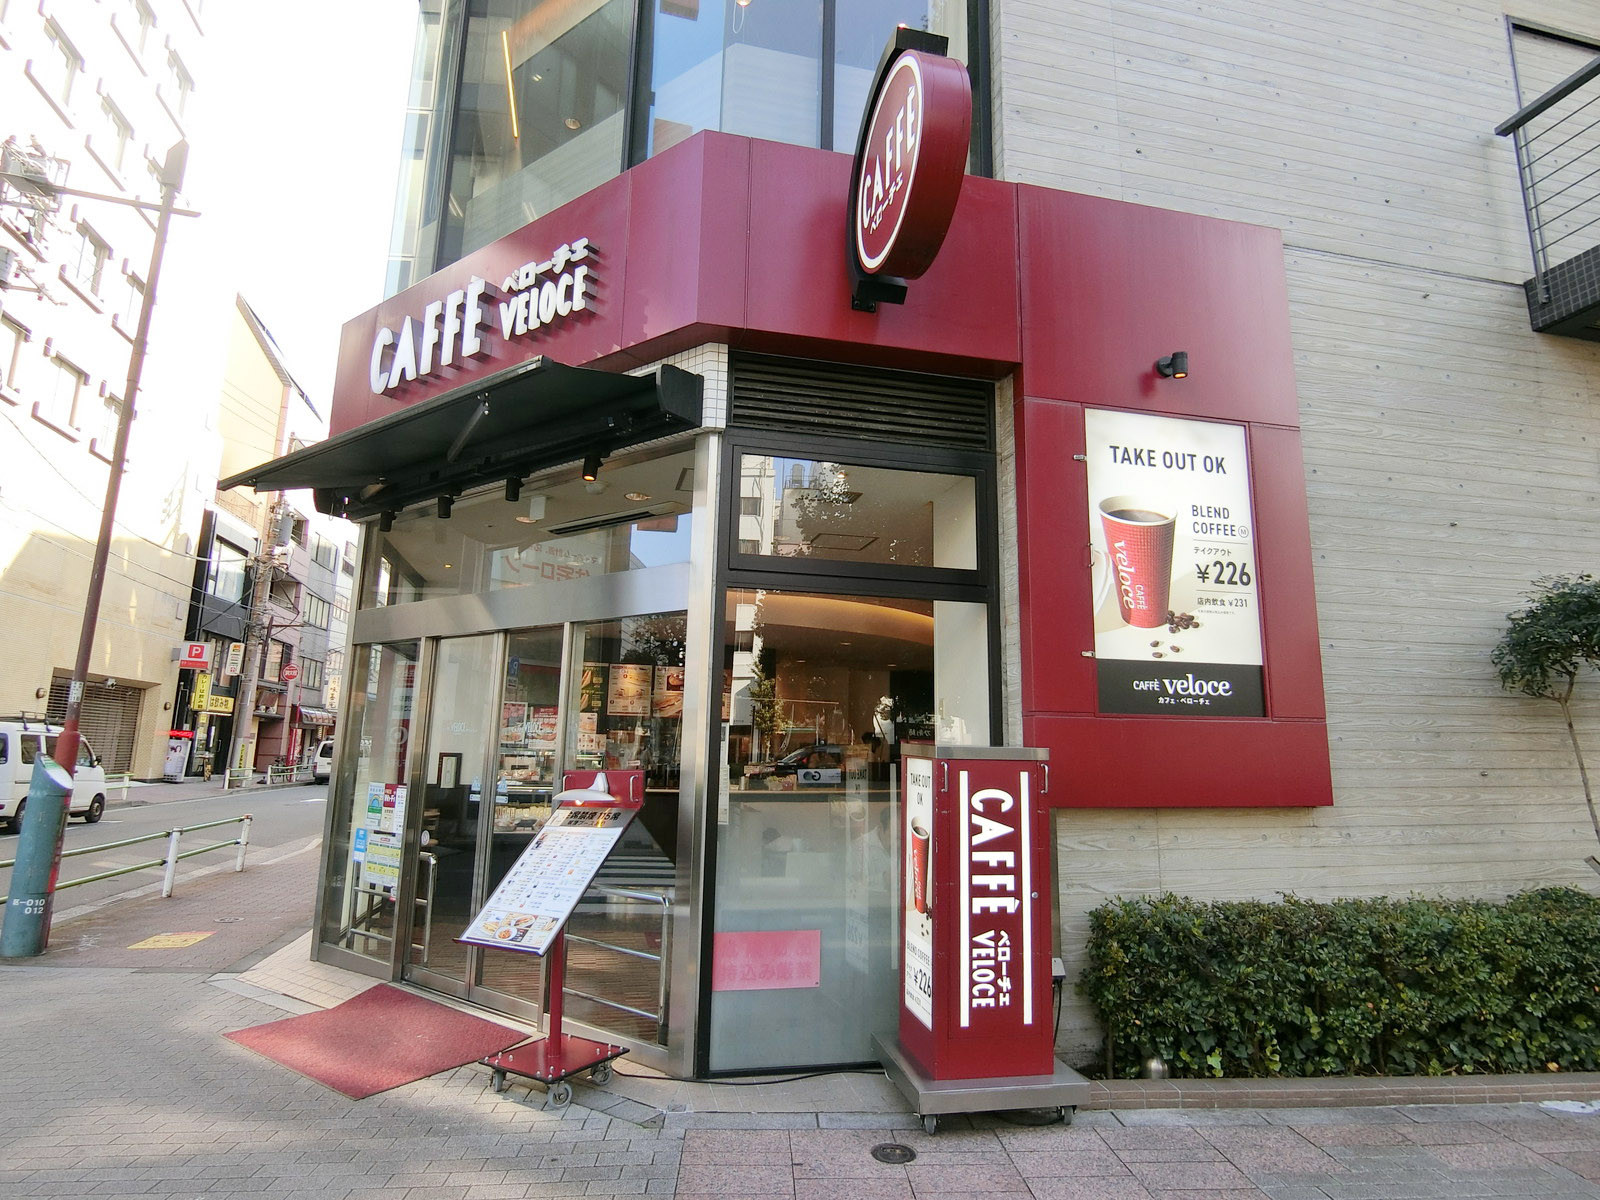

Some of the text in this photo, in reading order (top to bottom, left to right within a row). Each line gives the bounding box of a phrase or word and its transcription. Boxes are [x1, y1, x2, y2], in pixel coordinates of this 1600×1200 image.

[862, 85, 915, 229] CAFFÈ
[870, 172, 904, 235] ベローチェ
[501, 238, 589, 293] ベローチェ
[369, 264, 588, 395] CAFFÈ VELOCE
[1109, 445, 1227, 475] TAKE OUT OK
[1191, 504, 1230, 520] BLEND
[1192, 521, 1237, 538] COFFEE
[1193, 546, 1232, 557] テイクアウト
[1113, 540, 1136, 610] veloce
[1195, 560, 1251, 587] ¥226
[1134, 584, 1148, 610] CAFFÈ
[1196, 597, 1248, 608] 店内飲食 ¥231
[192, 647, 201, 657] P
[1133, 673, 1233, 697] CAFFÈ veloce
[1158, 695, 1210, 705] カフェ・ベローチェ
[910, 773, 931, 789] TAKE OUT
[916, 792, 924, 806] OK
[970, 788, 1020, 914] CAFFÈ
[25, 906, 44, 914] 012
[971, 929, 996, 1008] VELOCE
[997, 930, 1012, 1006] ベローチェ
[913, 967, 931, 998] ¥226
